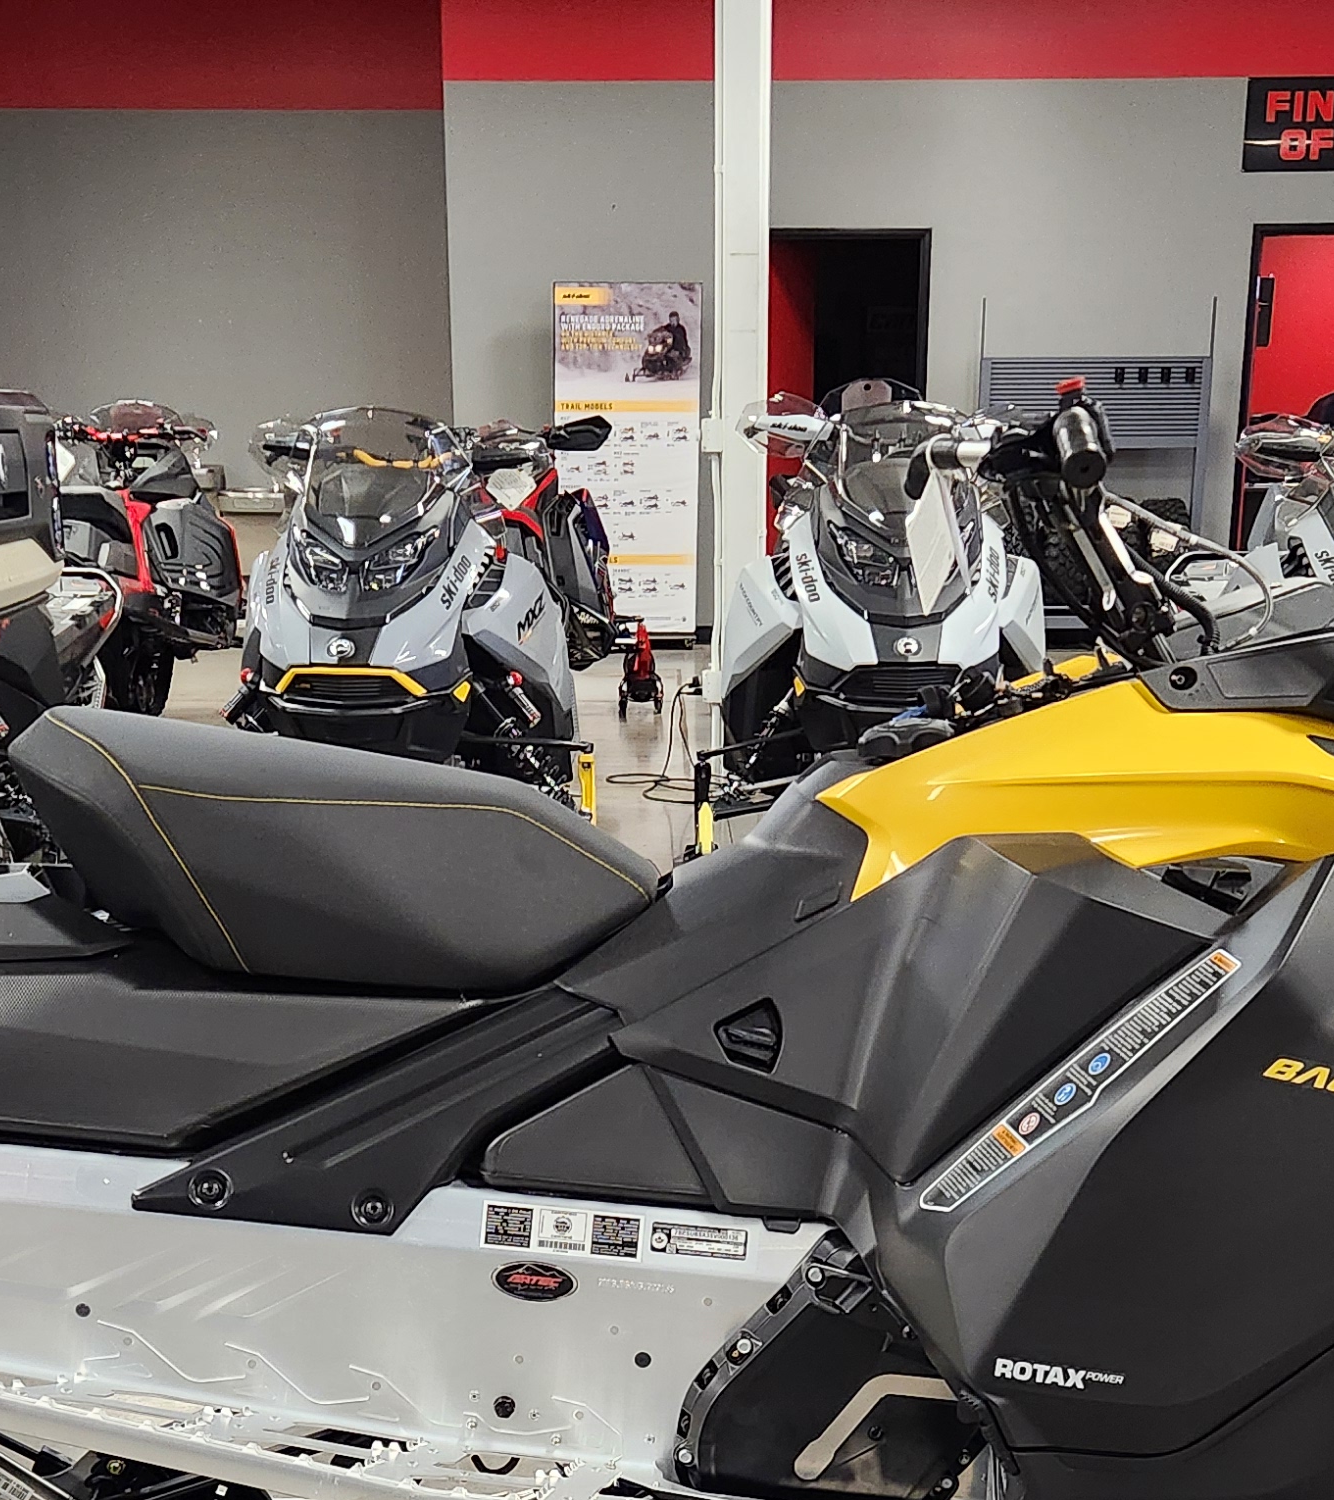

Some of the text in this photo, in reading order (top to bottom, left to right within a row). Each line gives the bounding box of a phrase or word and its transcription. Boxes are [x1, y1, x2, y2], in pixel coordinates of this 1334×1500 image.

[770, 422, 807, 433] ski-doo
[440, 554, 472, 611] ski-doo
[795, 552, 820, 603] ski-doo
[993, 1357, 1125, 1390] ROTAX POWER
